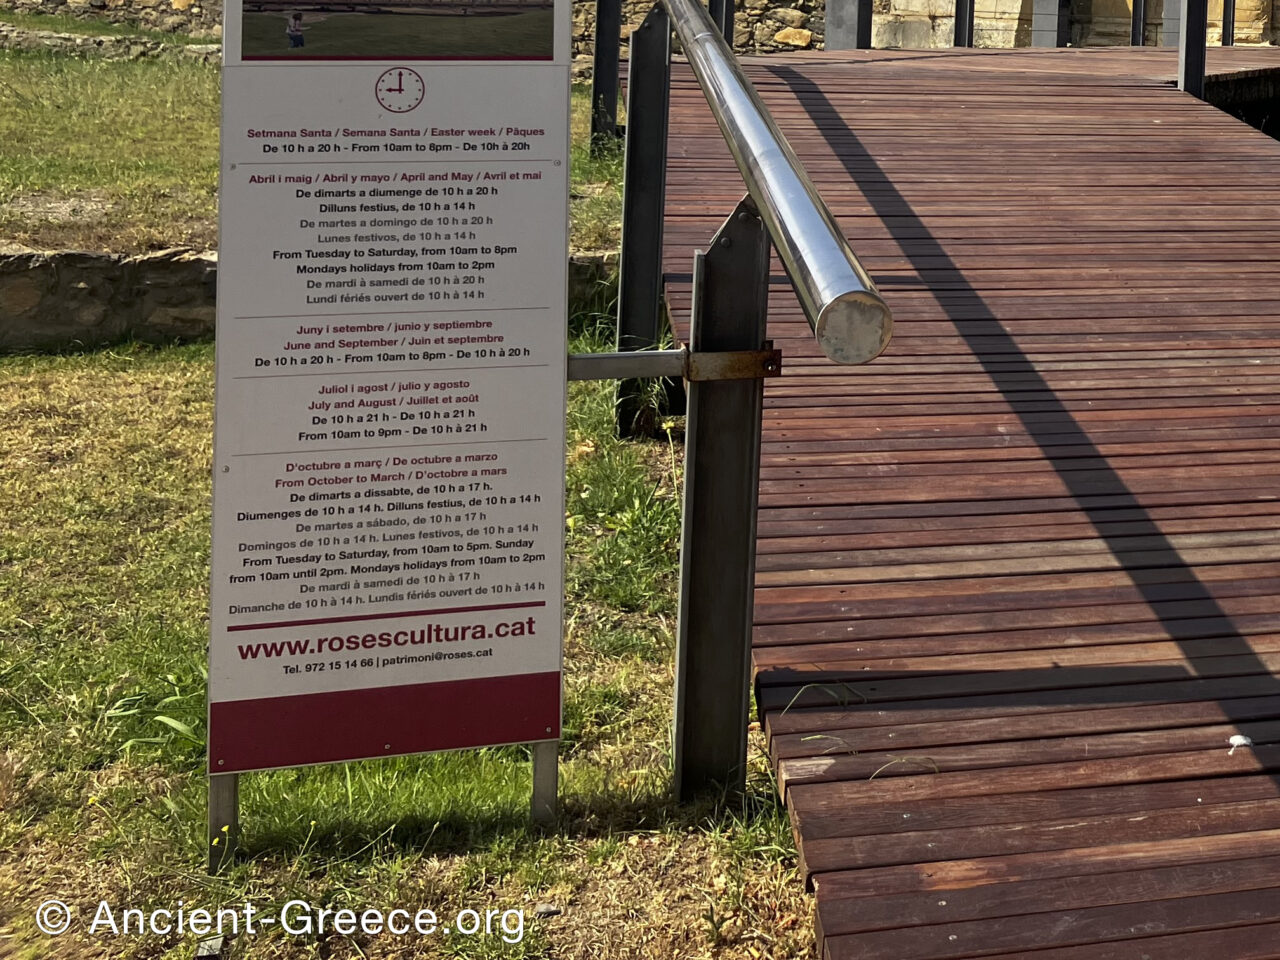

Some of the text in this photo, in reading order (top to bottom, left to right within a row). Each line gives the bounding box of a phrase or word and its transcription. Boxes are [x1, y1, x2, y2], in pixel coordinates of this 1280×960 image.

[246, 126, 545, 139] Setmana Santa Semana Santa Easter week Pâques
[350, 141, 530, 153] From 10am to 8pm 10h 20h
[247, 170, 542, 185] Abril maig Abril mayo April and May Avril et mai
[313, 187, 423, 199] dimarts diumenge
[318, 202, 399, 213] Dilluns festius,
[317, 217, 417, 228] martes domingo
[317, 232, 400, 244] Lunes festivos,
[272, 244, 517, 260] From Tuesday to Saturday, from 10am to 8pm
[295, 260, 495, 275] Mondays holidays from 10am to 2pm
[324, 276, 409, 289] mardi samedi
[305, 292, 409, 304] Lundi fériés ouvert
[295, 319, 493, 336] Juny setembre junio septiembre
[282, 333, 504, 351] June and September Juin et septembre
[343, 350, 446, 364] From 10am to 8pm
[317, 379, 470, 395] Juliol agost julio agosto
[307, 393, 479, 412] July and August Juillet et août
[311, 415, 328, 425] De
[297, 427, 402, 441] From 10am to 9pm
[285, 453, 498, 473] D'octubre març octubre marzo
[274, 467, 508, 489] From October to March D'octobre mars
[307, 486, 414, 502] dimarts dissabte,
[236, 498, 466, 522] Diumenges Dilluns festius,
[313, 516, 410, 532] martes sábado,
[237, 528, 464, 553] Domingos Lunes festivos,
[242, 538, 535, 567] From Tuesday to Saturday, from 10am to 5pm. Sunday
[228, 552, 546, 584] from 10am until 2pm. Mondays holidays from 10am to 2pm
[317, 576, 404, 592] mardi samedi
[228, 586, 472, 615] Dimanche Lundis fériés ouvert
[236, 616, 536, 660] www.rosescultura.cat
[282, 647, 493, 675] Tel. 972 15 14 66 patrimoni@roses.cat
